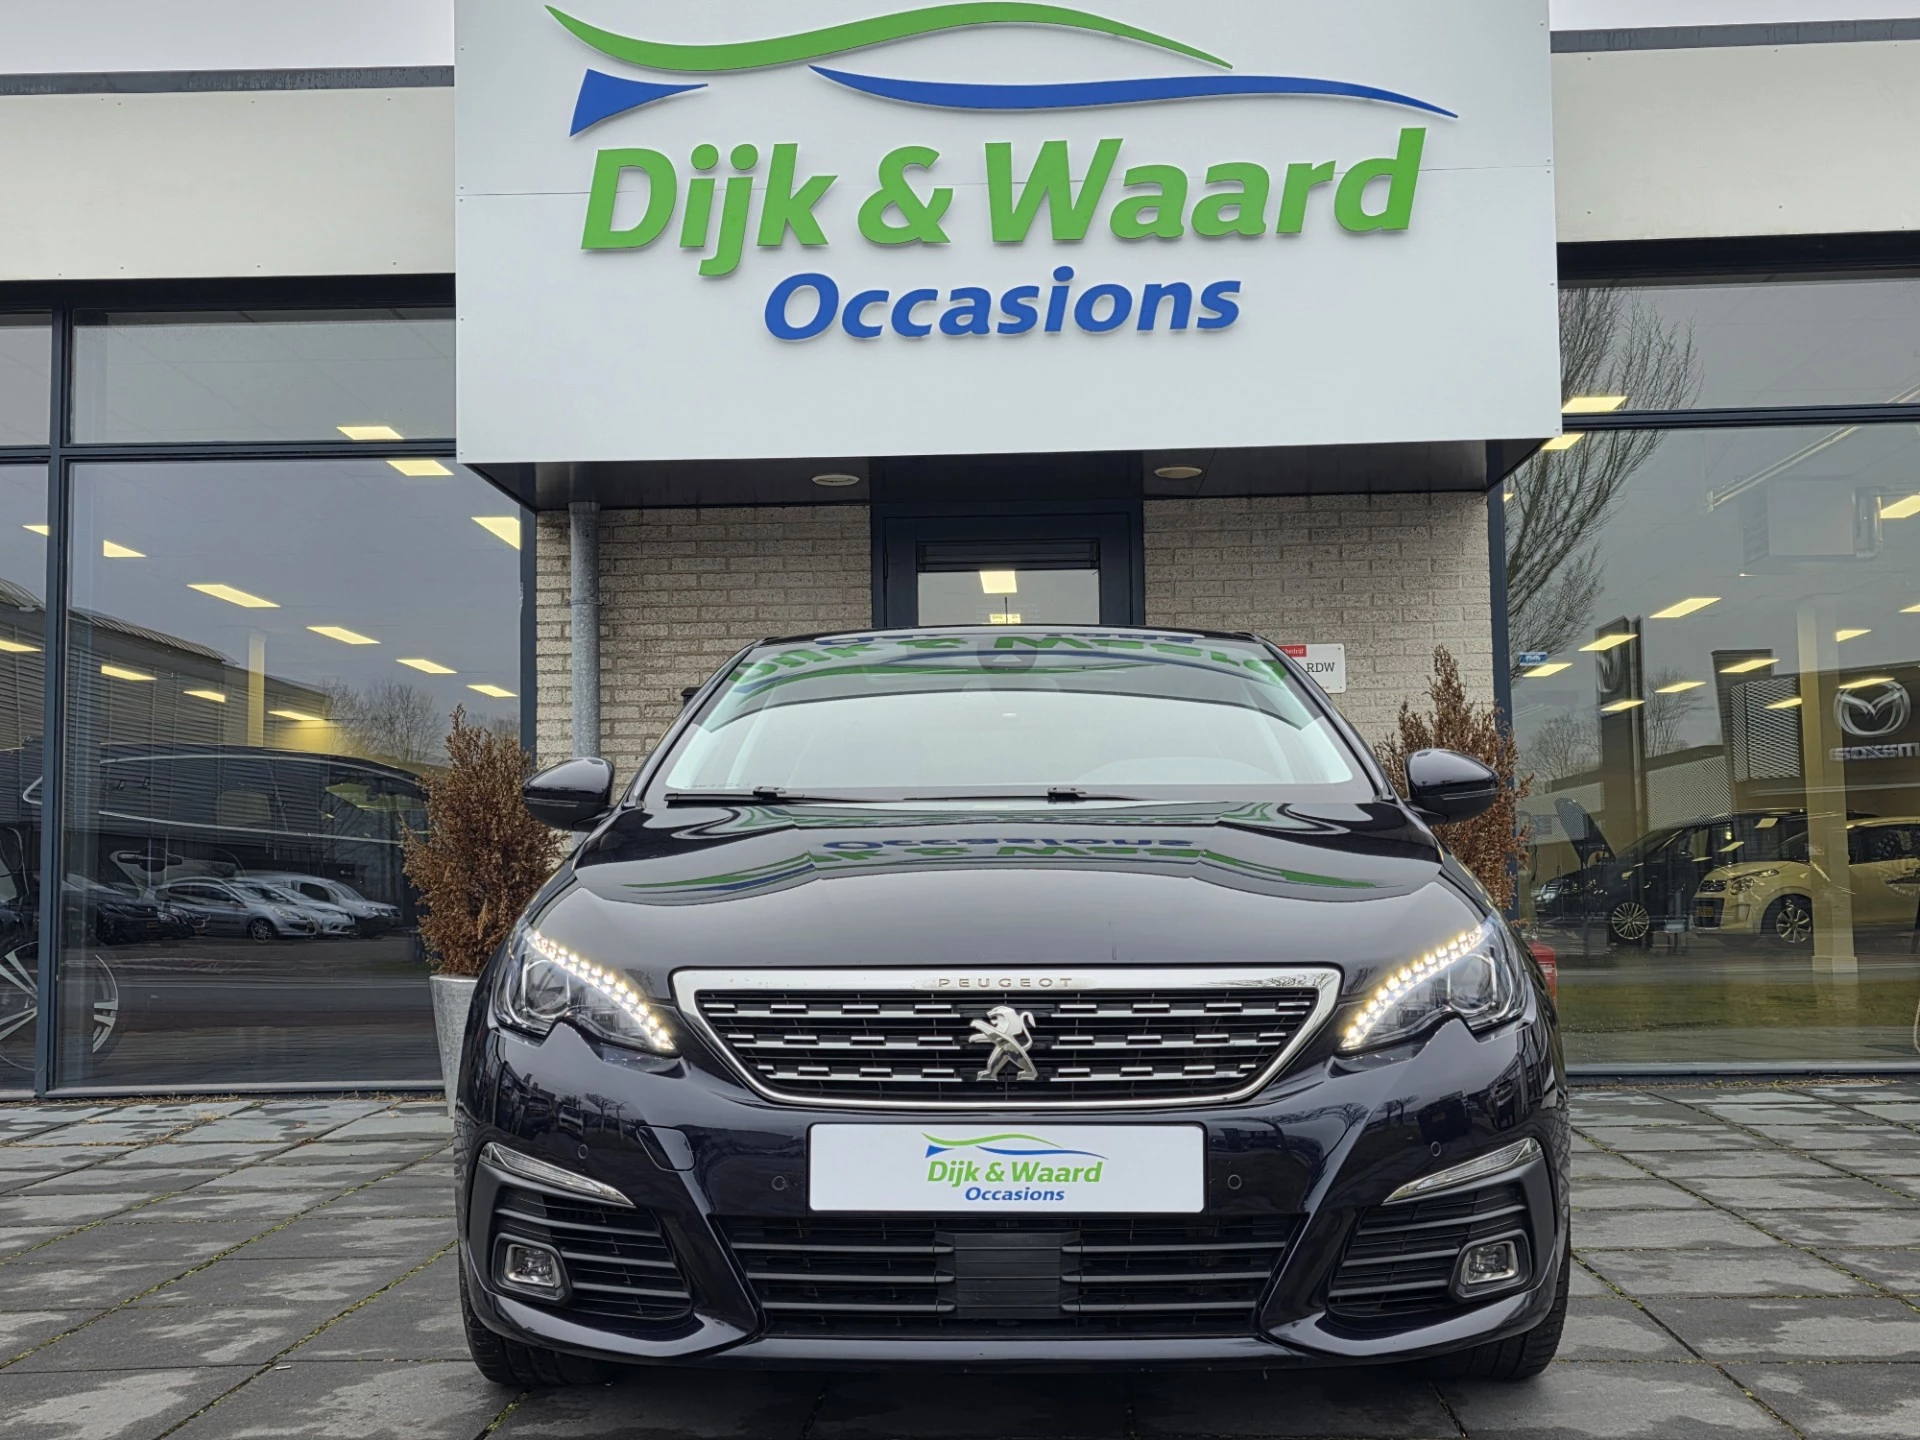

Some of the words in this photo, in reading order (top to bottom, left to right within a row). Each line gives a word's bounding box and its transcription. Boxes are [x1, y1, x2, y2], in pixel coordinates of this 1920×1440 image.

[582, 143, 836, 277] Dijk
[858, 146, 953, 245] &
[985, 127, 1426, 242] Waard
[764, 266, 1241, 341] Occasions
[1306, 661, 1336, 673] RDW
[938, 978, 1073, 988] PEUGEOT
[927, 1160, 980, 1187] Dijk
[985, 1161, 1005, 1183] &
[1011, 1161, 1103, 1183] Waard
[965, 1187, 1065, 1202] Occasions
